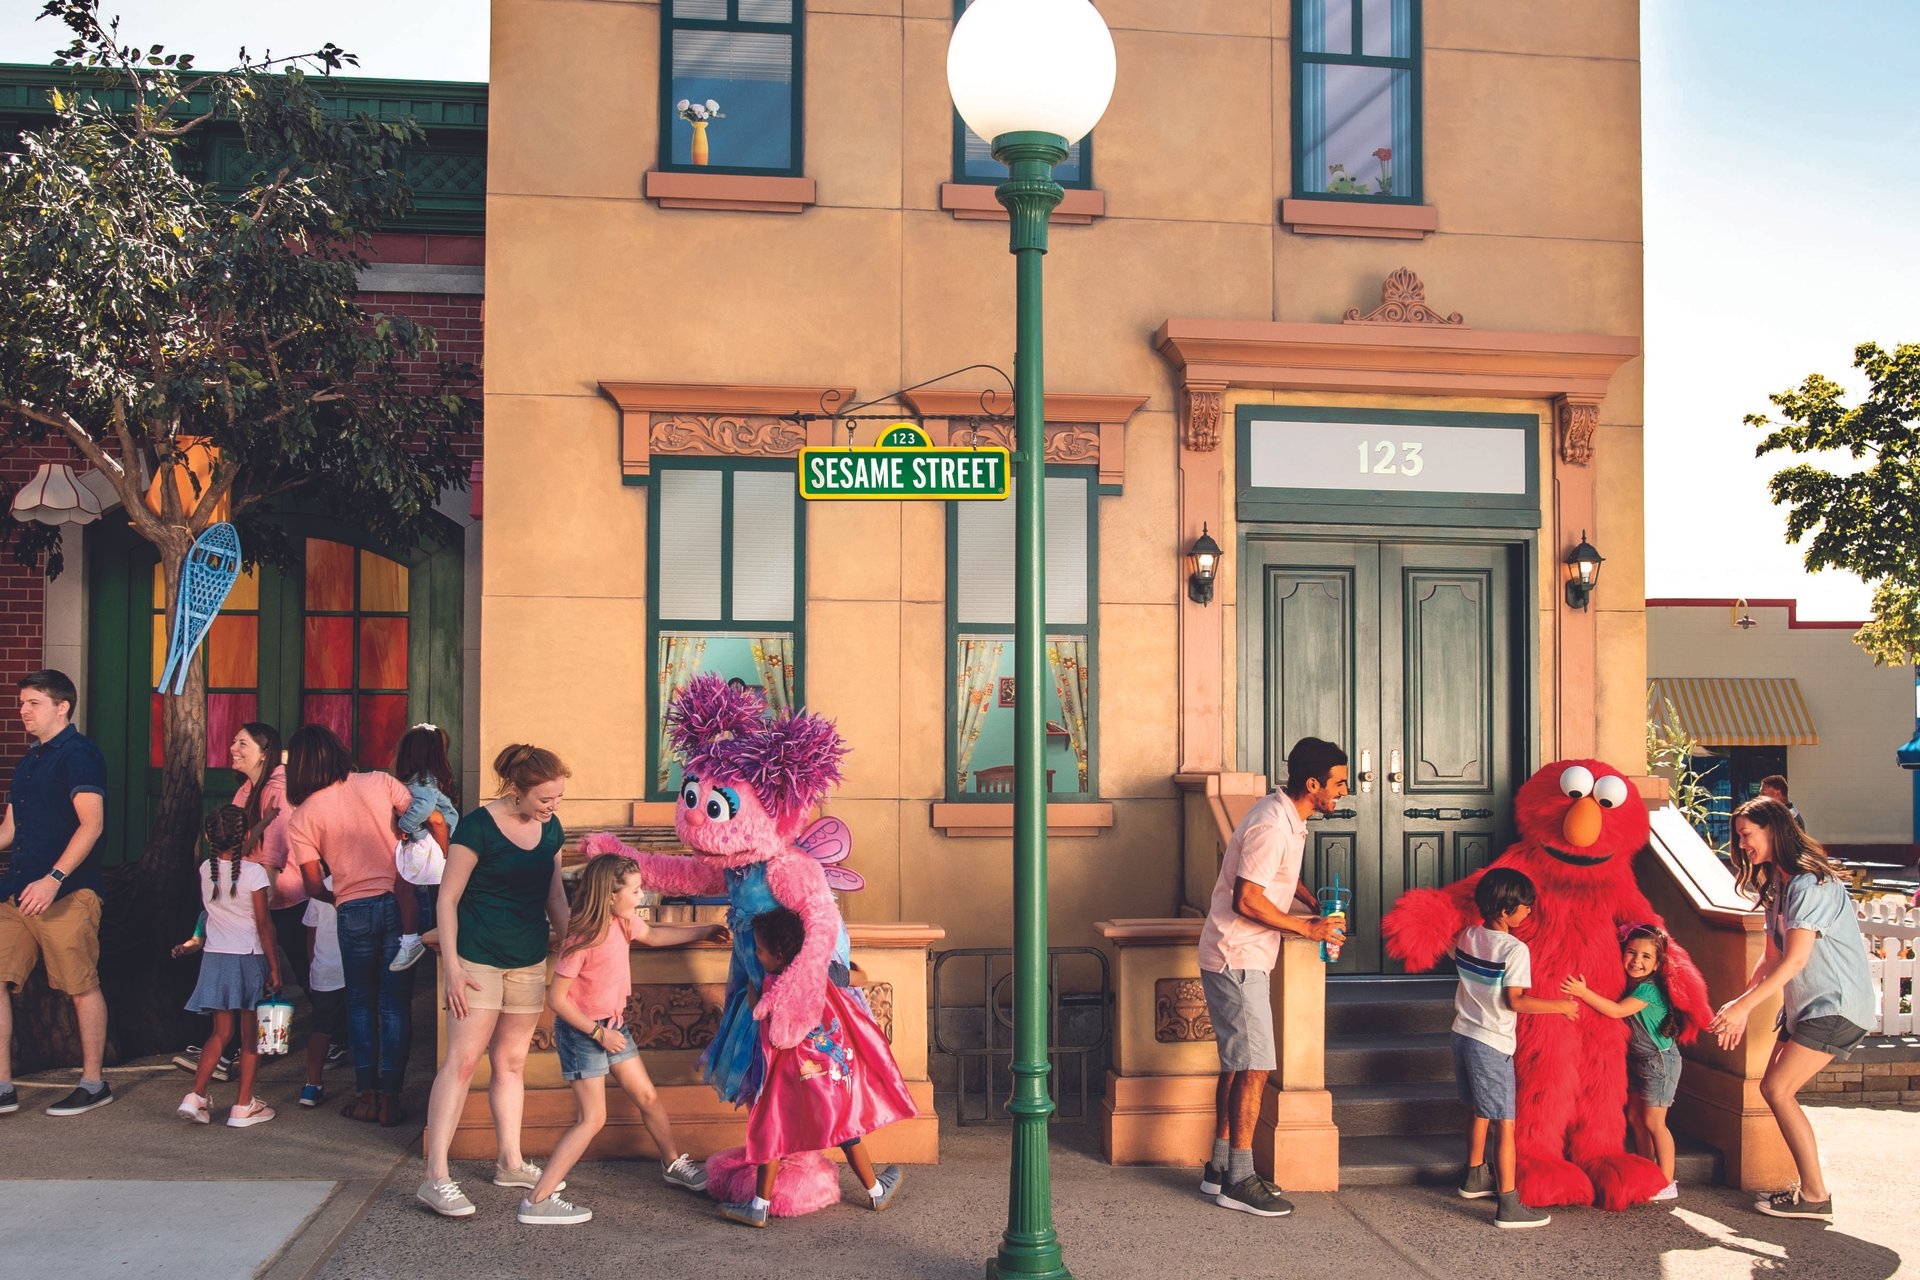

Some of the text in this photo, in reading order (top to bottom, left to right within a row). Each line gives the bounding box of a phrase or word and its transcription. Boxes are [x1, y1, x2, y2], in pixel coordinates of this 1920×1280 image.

[892, 432, 915, 445] 123
[810, 457, 999, 489] SESAME STREET
[1357, 440, 1425, 477] 123
